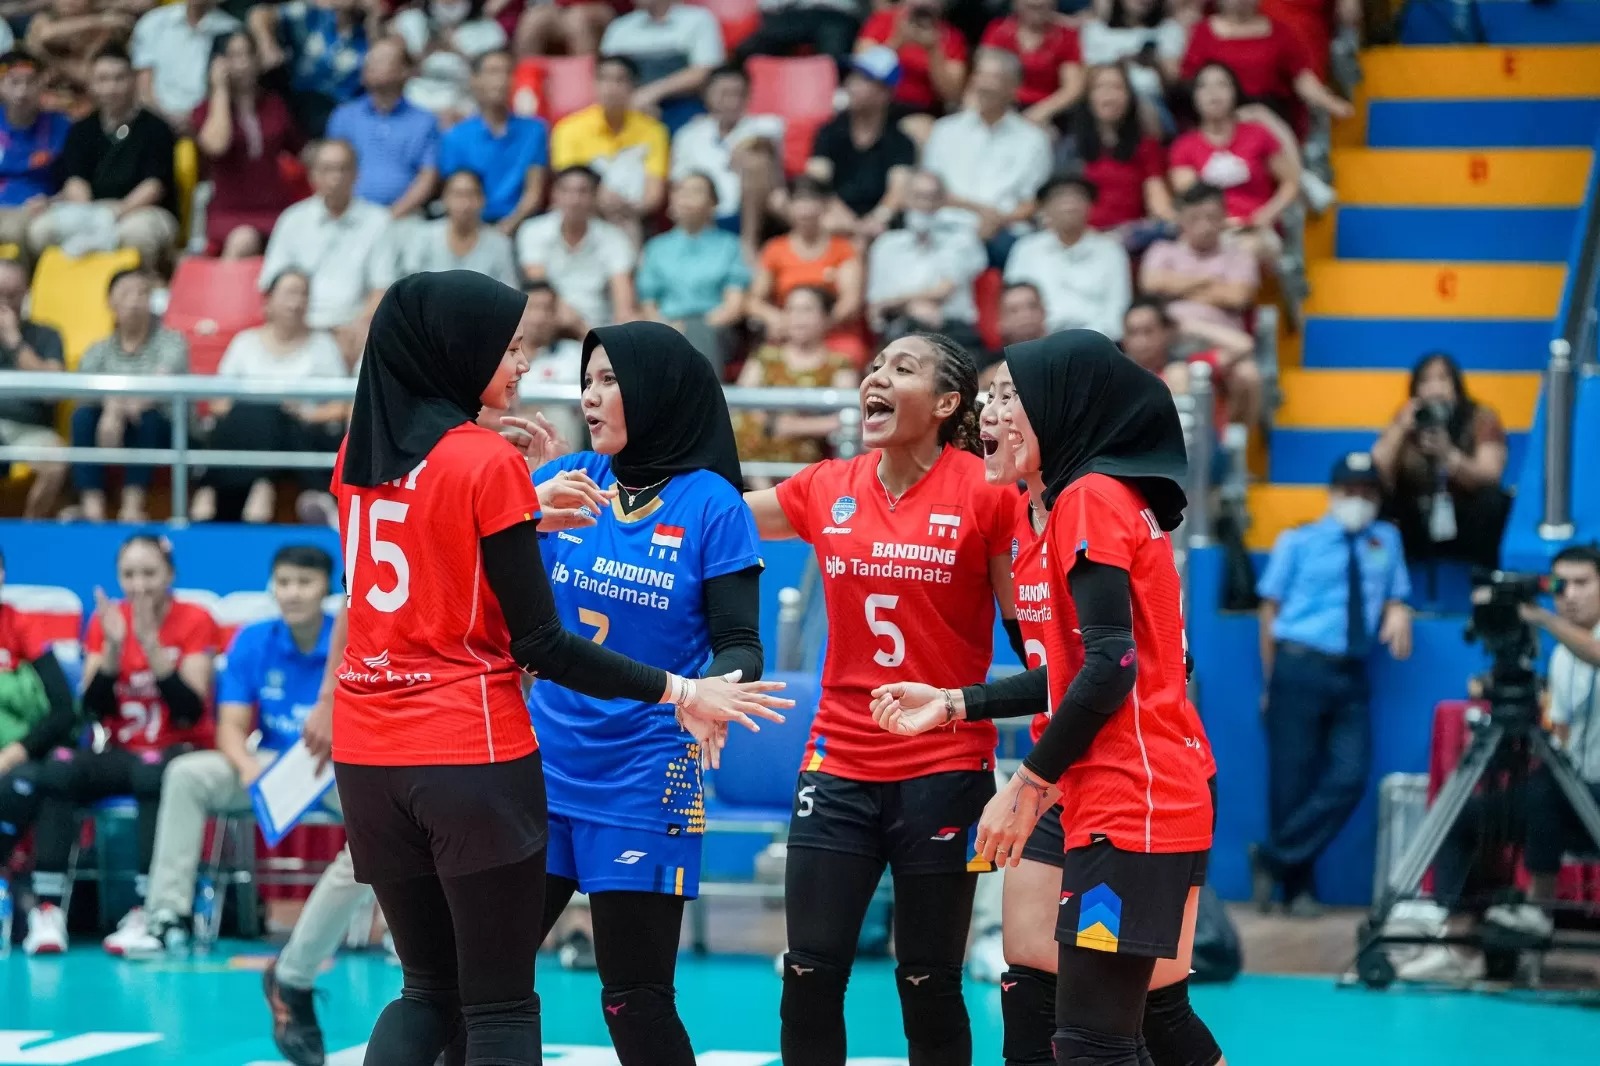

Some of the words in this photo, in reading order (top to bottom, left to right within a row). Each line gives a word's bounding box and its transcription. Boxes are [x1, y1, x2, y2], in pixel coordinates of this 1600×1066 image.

[345, 495, 410, 613] 15
[825, 556, 846, 579] bjb
[851, 559, 952, 584] Tandamata
[872, 542, 956, 565] BANDUNG
[573, 569, 670, 611] Tandamata
[592, 557, 675, 590] BANDUNG
[864, 593, 905, 668] 5
[797, 785, 817, 817] 5
